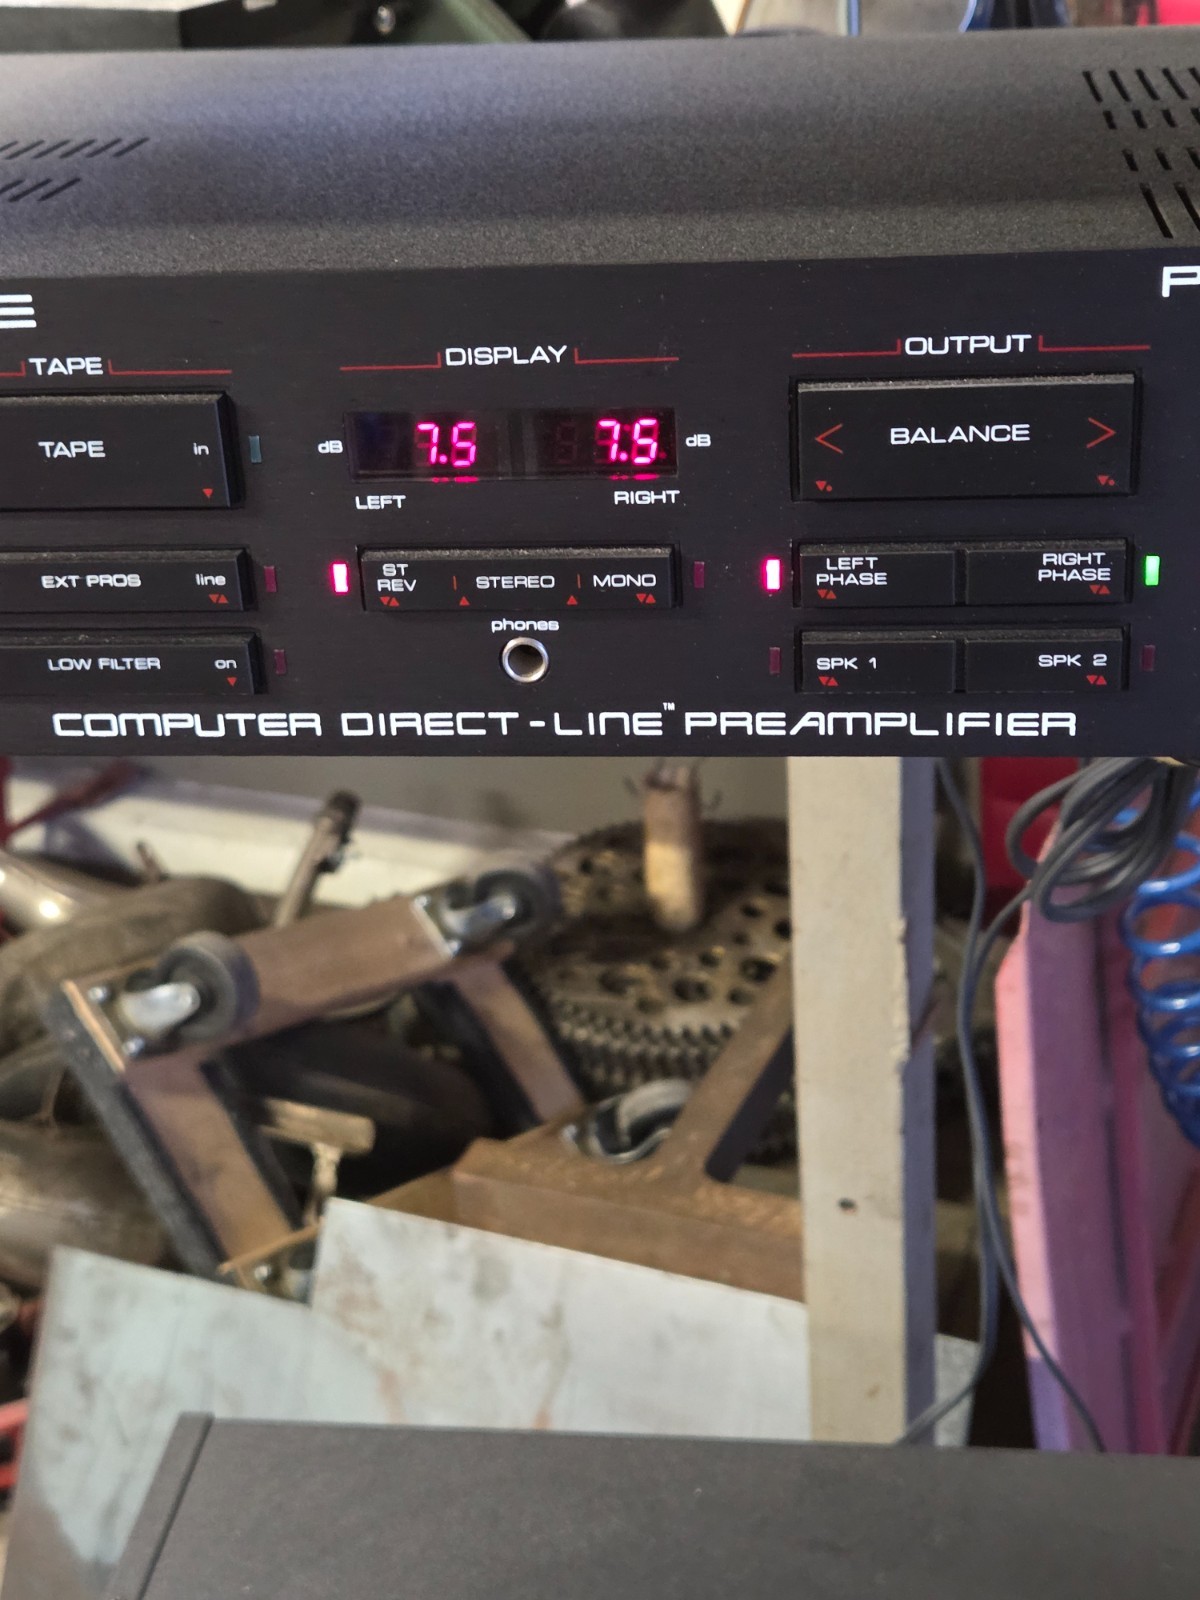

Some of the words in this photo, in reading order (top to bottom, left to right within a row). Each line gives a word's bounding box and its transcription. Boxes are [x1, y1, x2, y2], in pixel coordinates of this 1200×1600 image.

[905, 334, 1032, 355] OUTPUT
[445, 345, 567, 366] DISPLAY
[28, 356, 103, 375] TAPE
[686, 434, 711, 447] dB
[891, 424, 1030, 445] BALANCE
[193, 443, 209, 455] in
[318, 440, 343, 453] dB
[418, 422, 476, 467] 7.5
[598, 419, 658, 465] 7.5
[38, 441, 105, 458] TAPE
[355, 495, 406, 510] LEFT
[614, 490, 680, 505] RIGHT
[826, 557, 878, 570] LEFT
[1043, 552, 1105, 566] RIGHT
[383, 563, 408, 576] ST
[1038, 568, 1110, 582] PHASE
[41, 575, 80, 588] EXT
[86, 574, 141, 587] PROS
[196, 574, 226, 585] line
[377, 579, 416, 592] REV
[476, 576, 555, 589] STEREO
[593, 574, 656, 587] MONO
[816, 573, 887, 586] PHASE
[491, 618, 559, 633] phones
[48, 658, 92, 671] LOW
[98, 657, 161, 670] FILTER
[215, 660, 237, 669] on
[817, 657, 858, 670] SPK
[869, 657, 876, 669] 1
[1038, 654, 1081, 667] SPK
[1093, 654, 1107, 666] 2
[52, 713, 322, 737] COMPUTER
[685, 712, 1076, 736] PREAMPLIFIER
